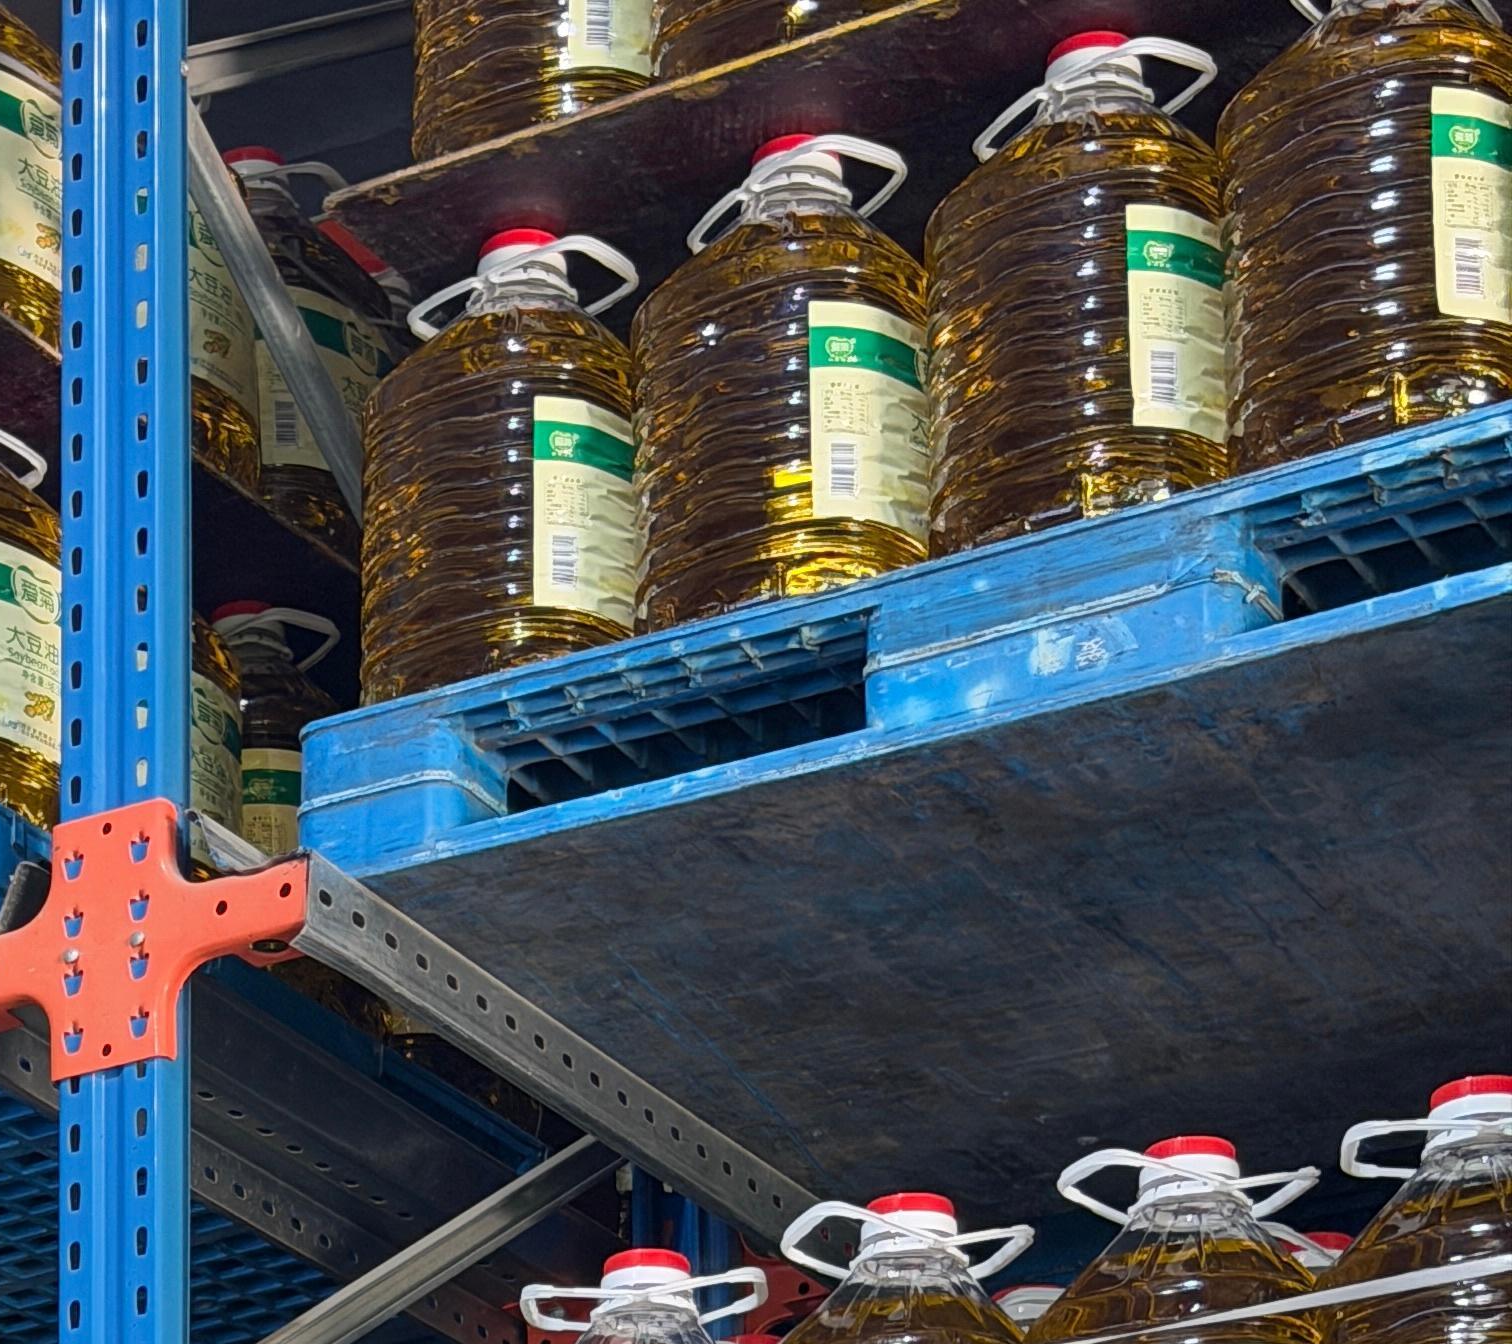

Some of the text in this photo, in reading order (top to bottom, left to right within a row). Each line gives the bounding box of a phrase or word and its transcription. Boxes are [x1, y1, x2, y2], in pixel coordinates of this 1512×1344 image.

[21, 578, 55, 614] 爱菊
[6, 626, 59, 666] 大豆油
